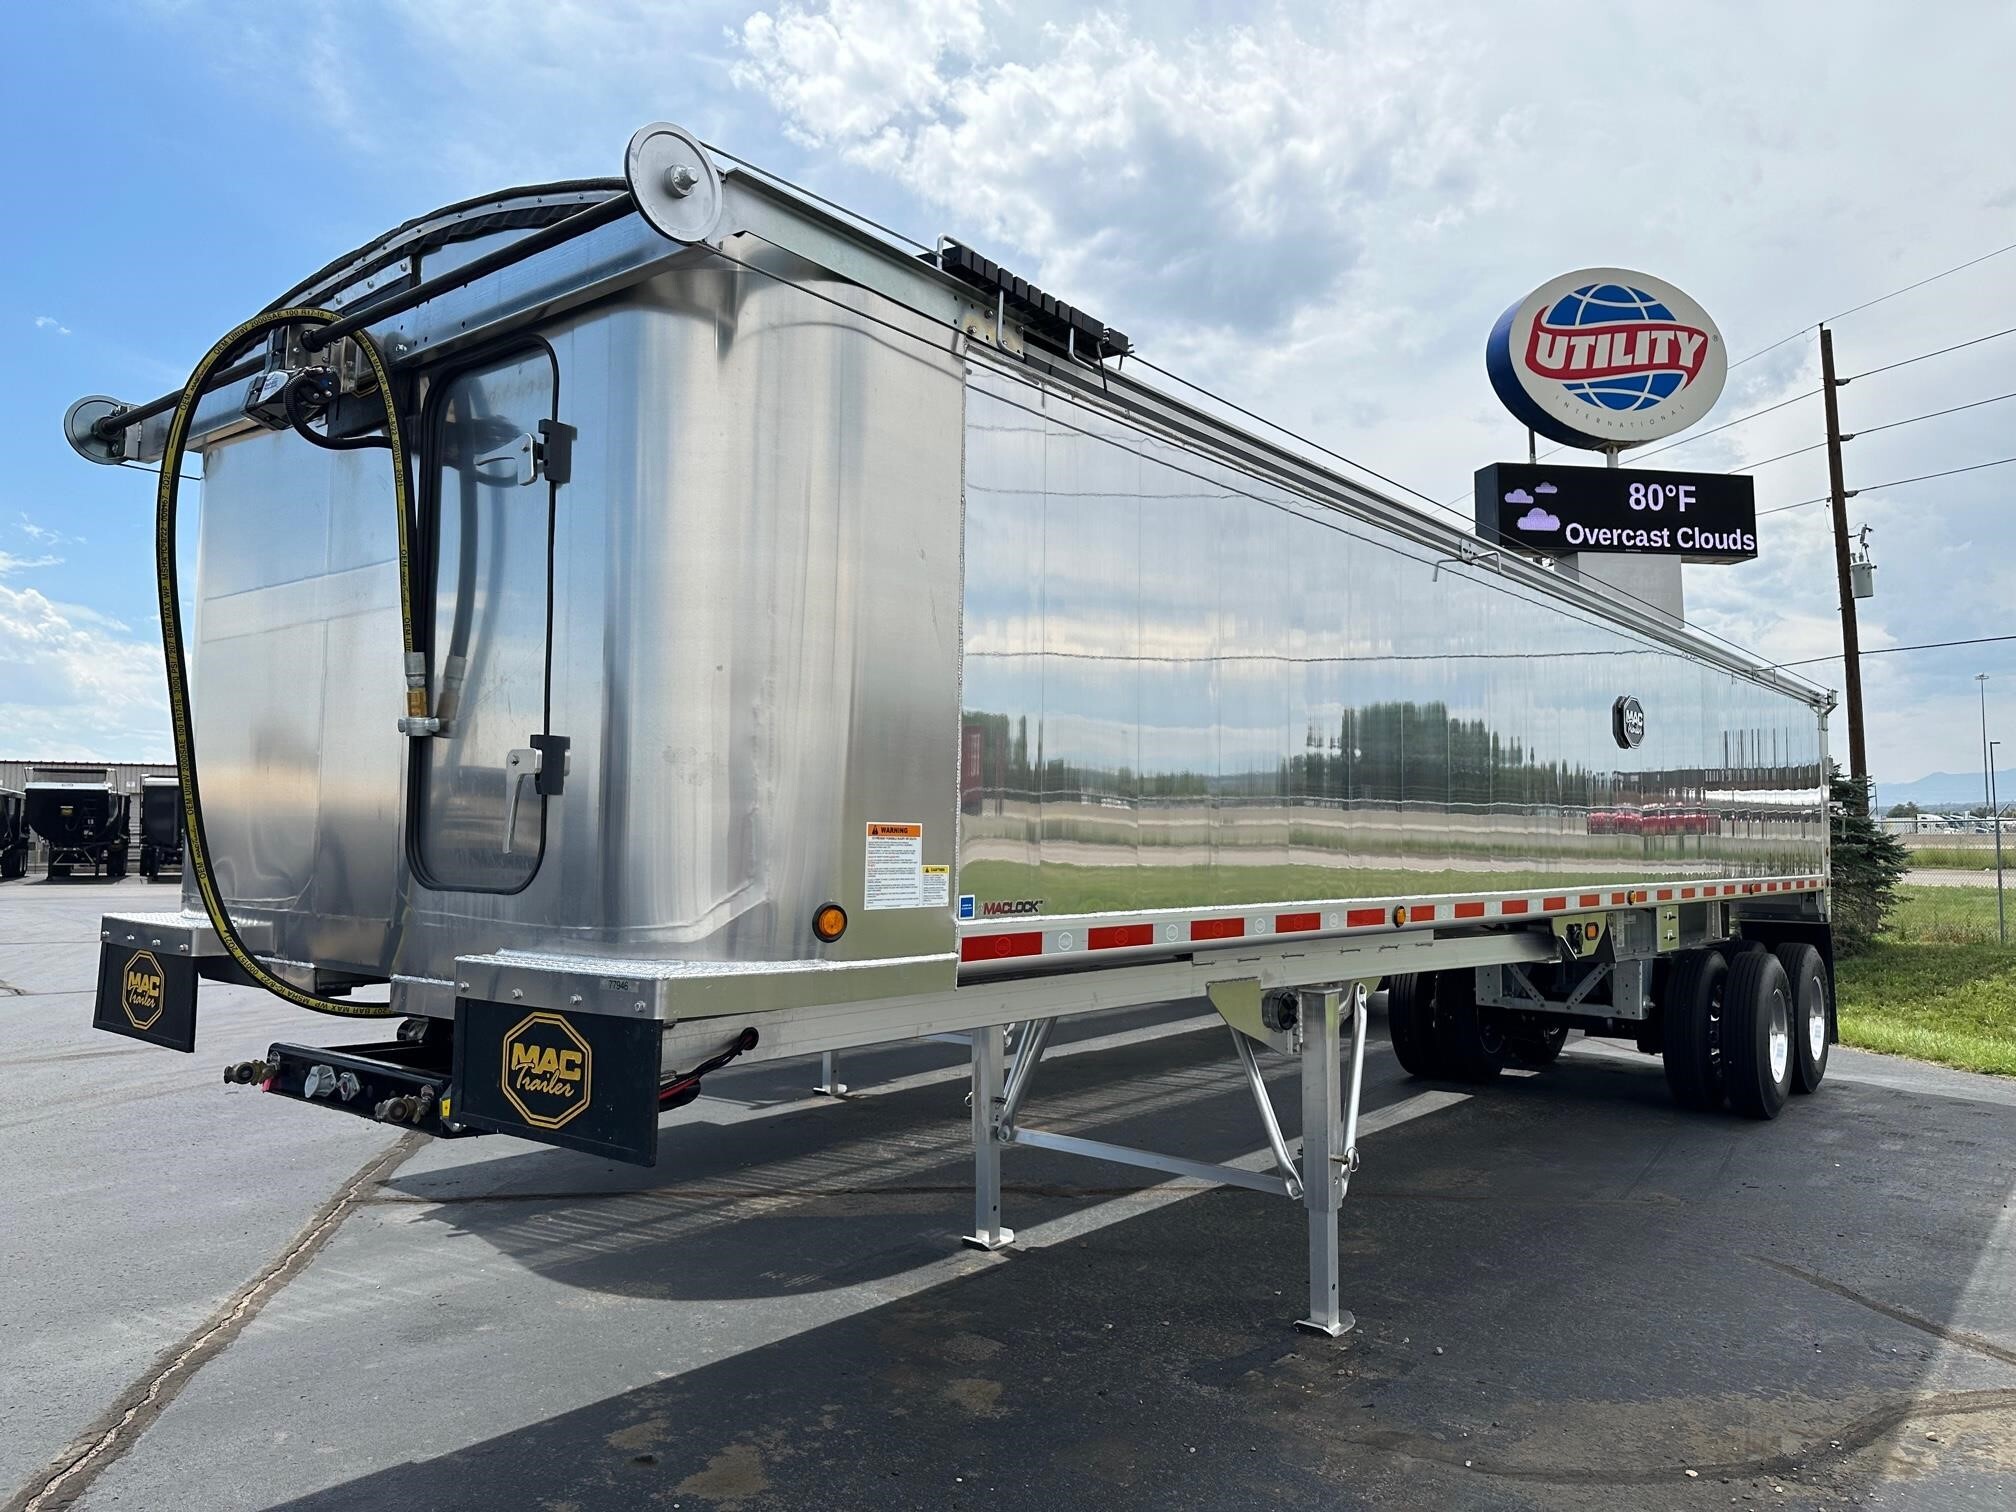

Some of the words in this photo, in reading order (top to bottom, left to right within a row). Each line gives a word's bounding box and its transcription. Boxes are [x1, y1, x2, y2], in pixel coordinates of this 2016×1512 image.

[1535, 330, 1705, 370] UTILITY
[1555, 394, 1685, 429] INTERNATIONAL
[1628, 483, 1697, 512] 80°F
[1565, 523, 1670, 548] Overcast
[1677, 525, 1755, 550] Clouds
[880, 826, 909, 834] WARNING
[128, 971, 160, 997] MAC
[128, 985, 156, 1008] Trailer
[607, 979, 629, 990] 77946
[511, 1042, 582, 1081] MAC
[514, 1062, 575, 1098] Trailer
